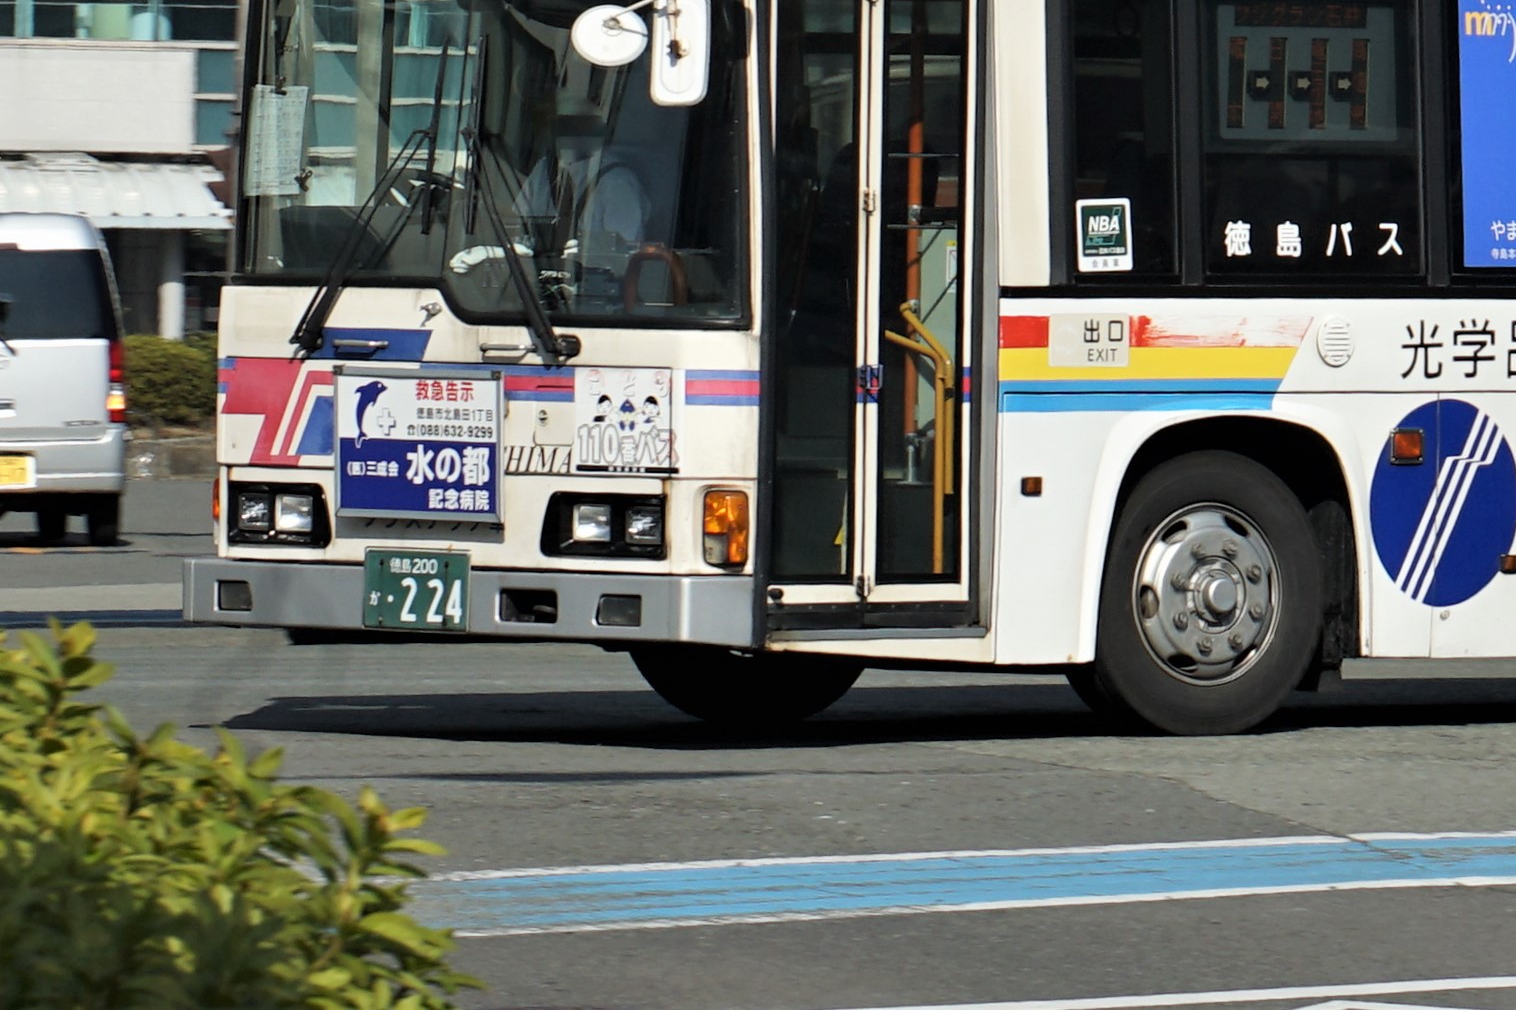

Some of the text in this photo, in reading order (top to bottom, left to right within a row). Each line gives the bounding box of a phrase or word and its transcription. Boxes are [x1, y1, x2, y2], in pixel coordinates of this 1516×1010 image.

[1088, 215, 1120, 233] NBA
[1224, 221, 1403, 257] 徳島バス
[1084, 318, 1123, 343] 出口
[1087, 348, 1118, 362] EXIT
[415, 381, 475, 402] 救急告示
[417, 425, 493, 439] (088)632-9299
[406, 444, 490, 486] 水の都
[428, 489, 490, 511] 記念病院
